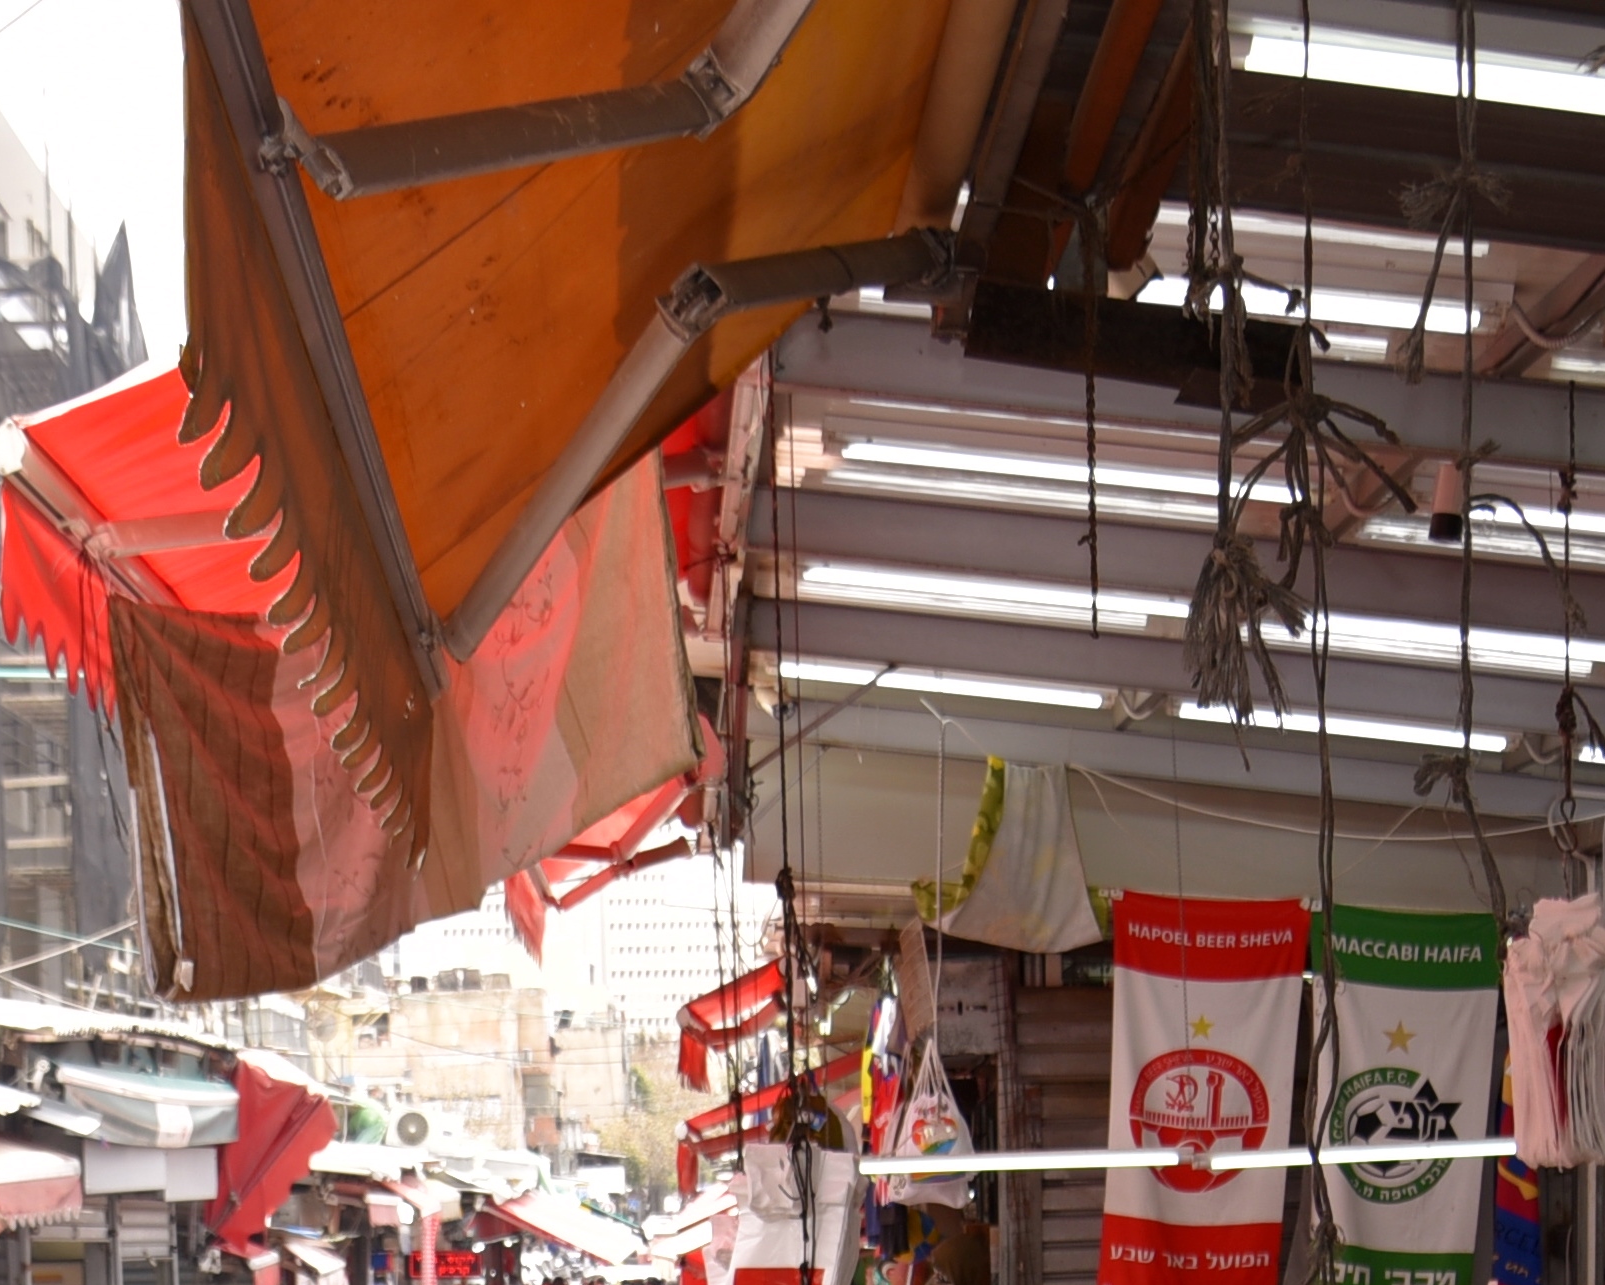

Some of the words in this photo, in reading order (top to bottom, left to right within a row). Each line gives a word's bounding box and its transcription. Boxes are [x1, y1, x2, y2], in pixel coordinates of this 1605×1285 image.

[1128, 922, 1192, 946] HAPOEL
[1196, 933, 1236, 948] BEER
[1240, 927, 1293, 948] SHEVA
[1331, 934, 1419, 962] MACCABI
[1424, 945, 1482, 963] HAIFA
[1110, 1245, 1155, 1264] שבע
[1163, 1252, 1199, 1270] באר
[1205, 1251, 1270, 1271] הפועל
